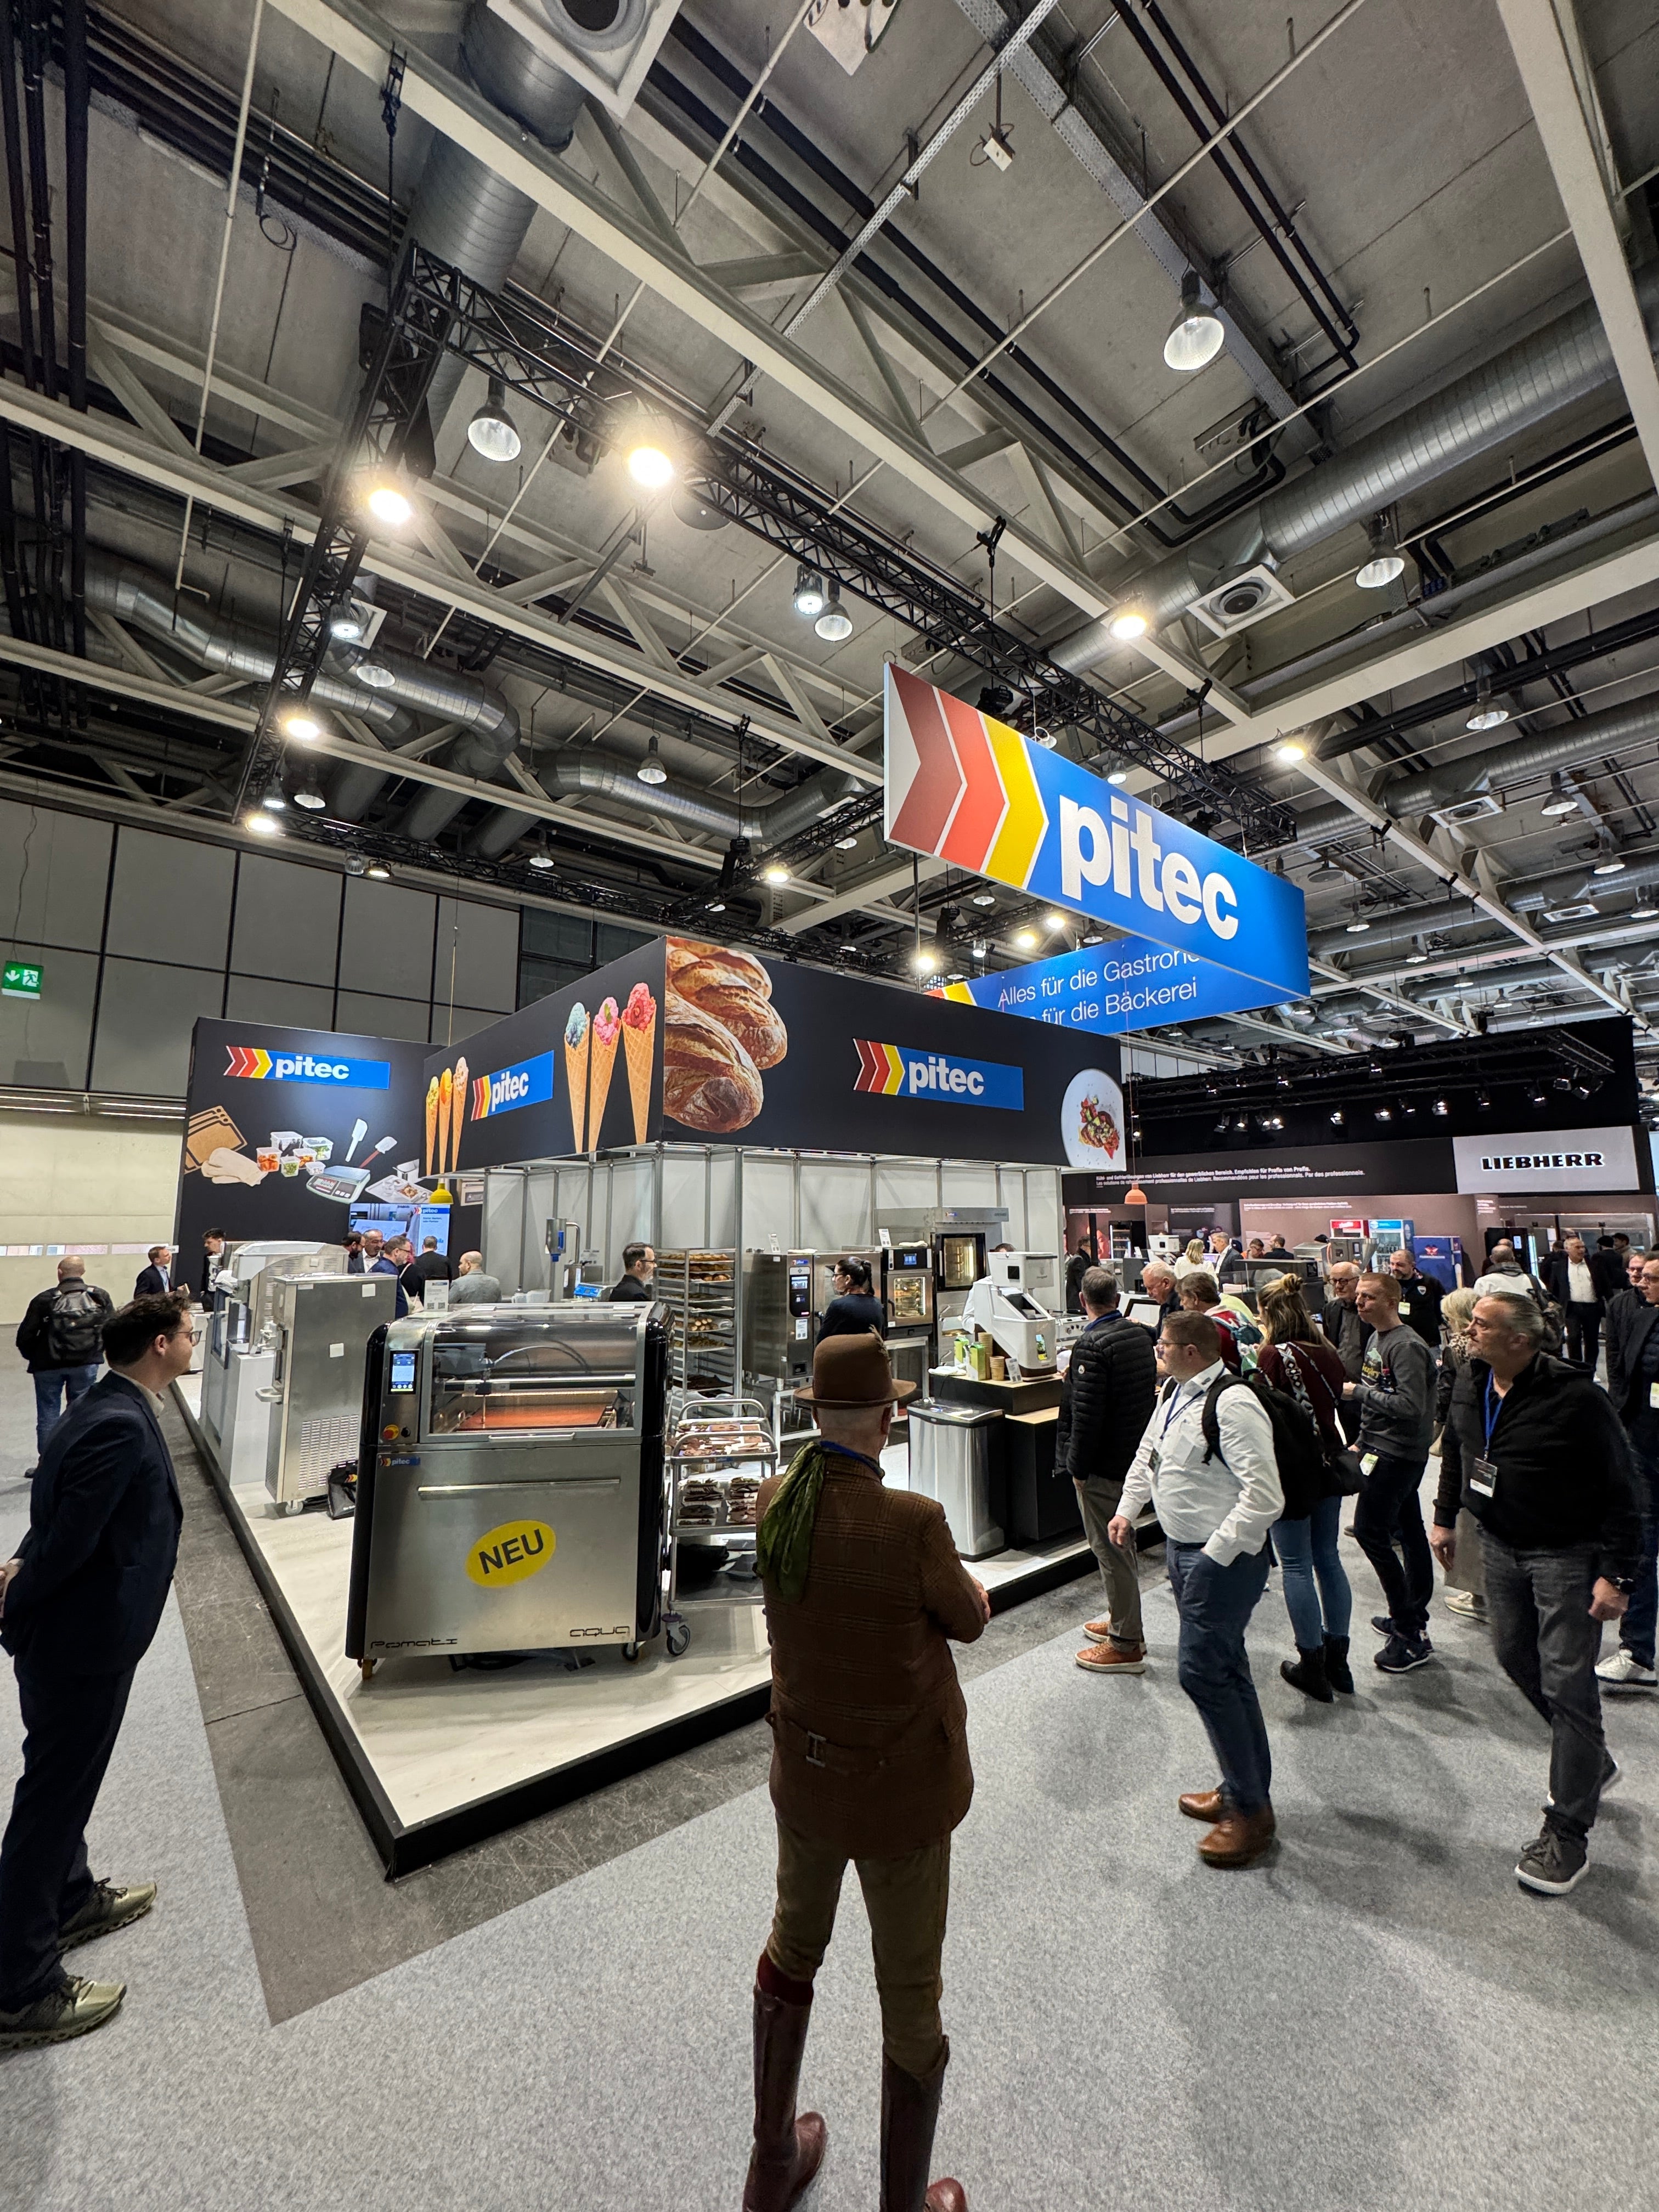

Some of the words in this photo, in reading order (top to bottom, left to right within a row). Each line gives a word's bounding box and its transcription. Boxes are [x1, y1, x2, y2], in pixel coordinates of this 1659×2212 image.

[1059, 795, 1239, 940] pitec
[997, 986, 1036, 1008] Alles
[1041, 976, 1065, 997] für
[1070, 968, 1098, 990] die
[1042, 1007, 1065, 1025] für
[1071, 1000, 1099, 1022] die
[1105, 976, 1197, 1015] Bäckerei
[275, 1056, 349, 1080] pitec
[909, 1056, 985, 1096] pitec
[491, 1071, 529, 1112] pitec
[1482, 1153, 1604, 1170] LIEBHERR
[391, 1458, 410, 1466] pitec
[478, 1528, 544, 1575] NEU
